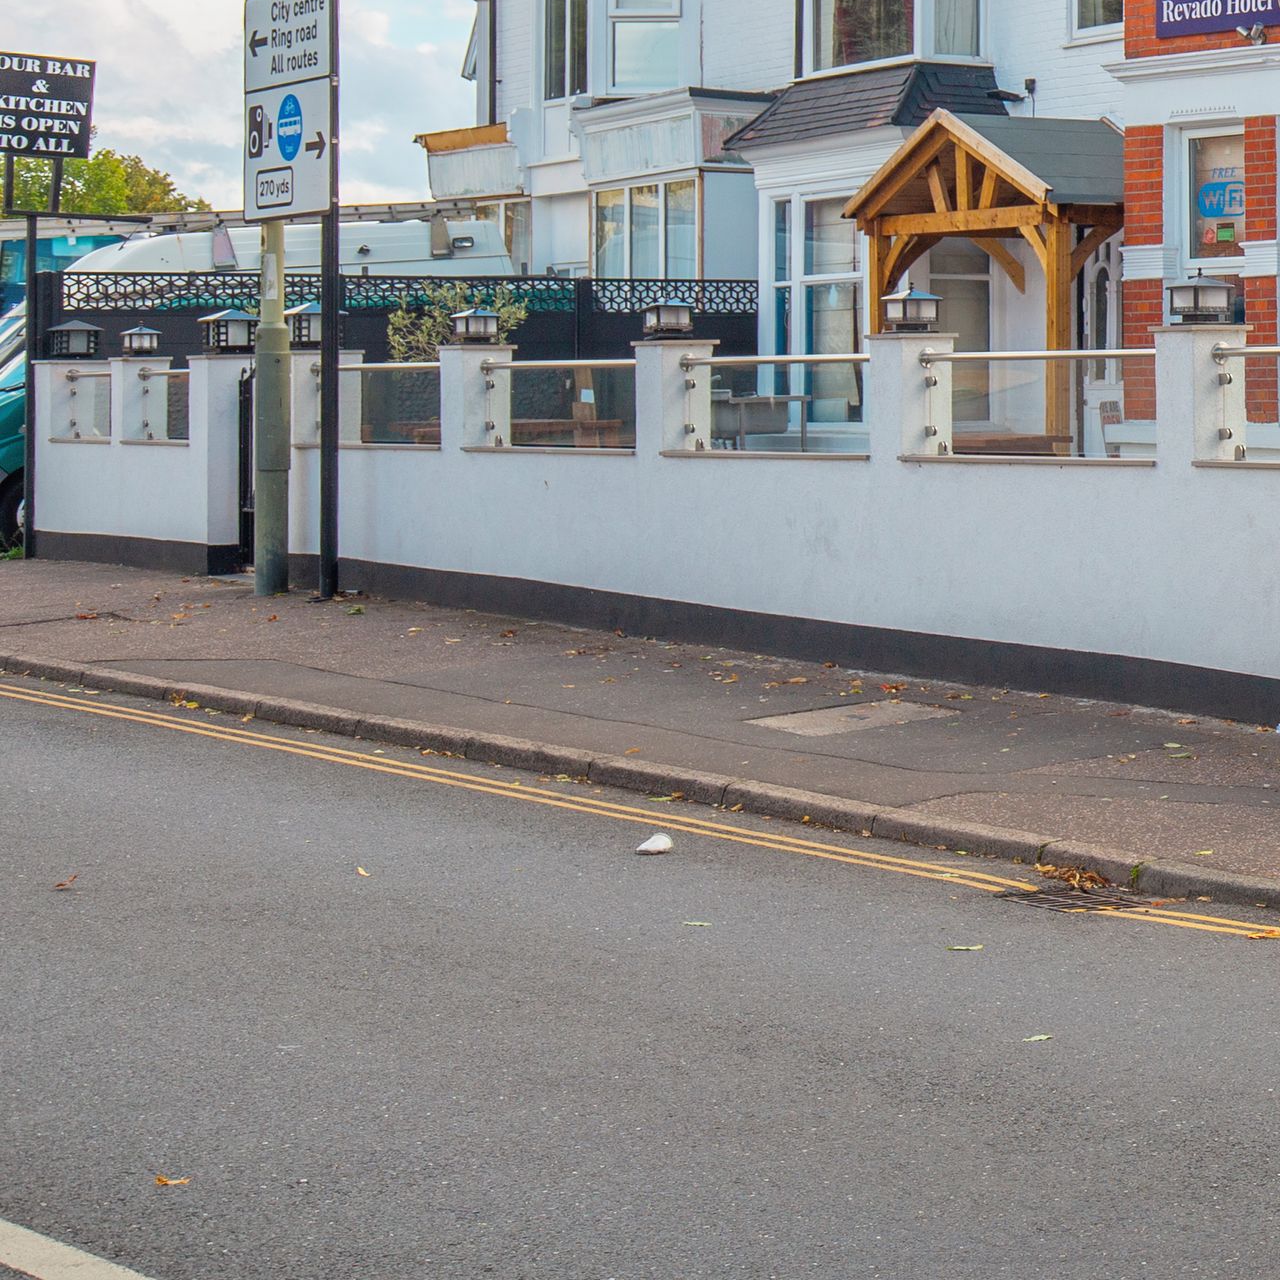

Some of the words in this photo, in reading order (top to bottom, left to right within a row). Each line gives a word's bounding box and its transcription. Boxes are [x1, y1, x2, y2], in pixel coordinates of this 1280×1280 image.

[271, 0, 290, 23] City
[271, 28, 292, 49] Ring
[295, 19, 317, 43] road
[0, 55, 41, 73] OUR
[46, 60, 91, 78] BAR
[270, 54, 284, 75] All
[287, 48, 318, 71] routes
[31, 78, 50, 94] &
[21, 116, 82, 135] OPEN
[0, 133, 29, 150] TO
[32, 136, 75, 153] ALL
[1211, 167, 1237, 179] FREE
[260, 180, 275, 196] 270
[276, 178, 290, 198] yds
